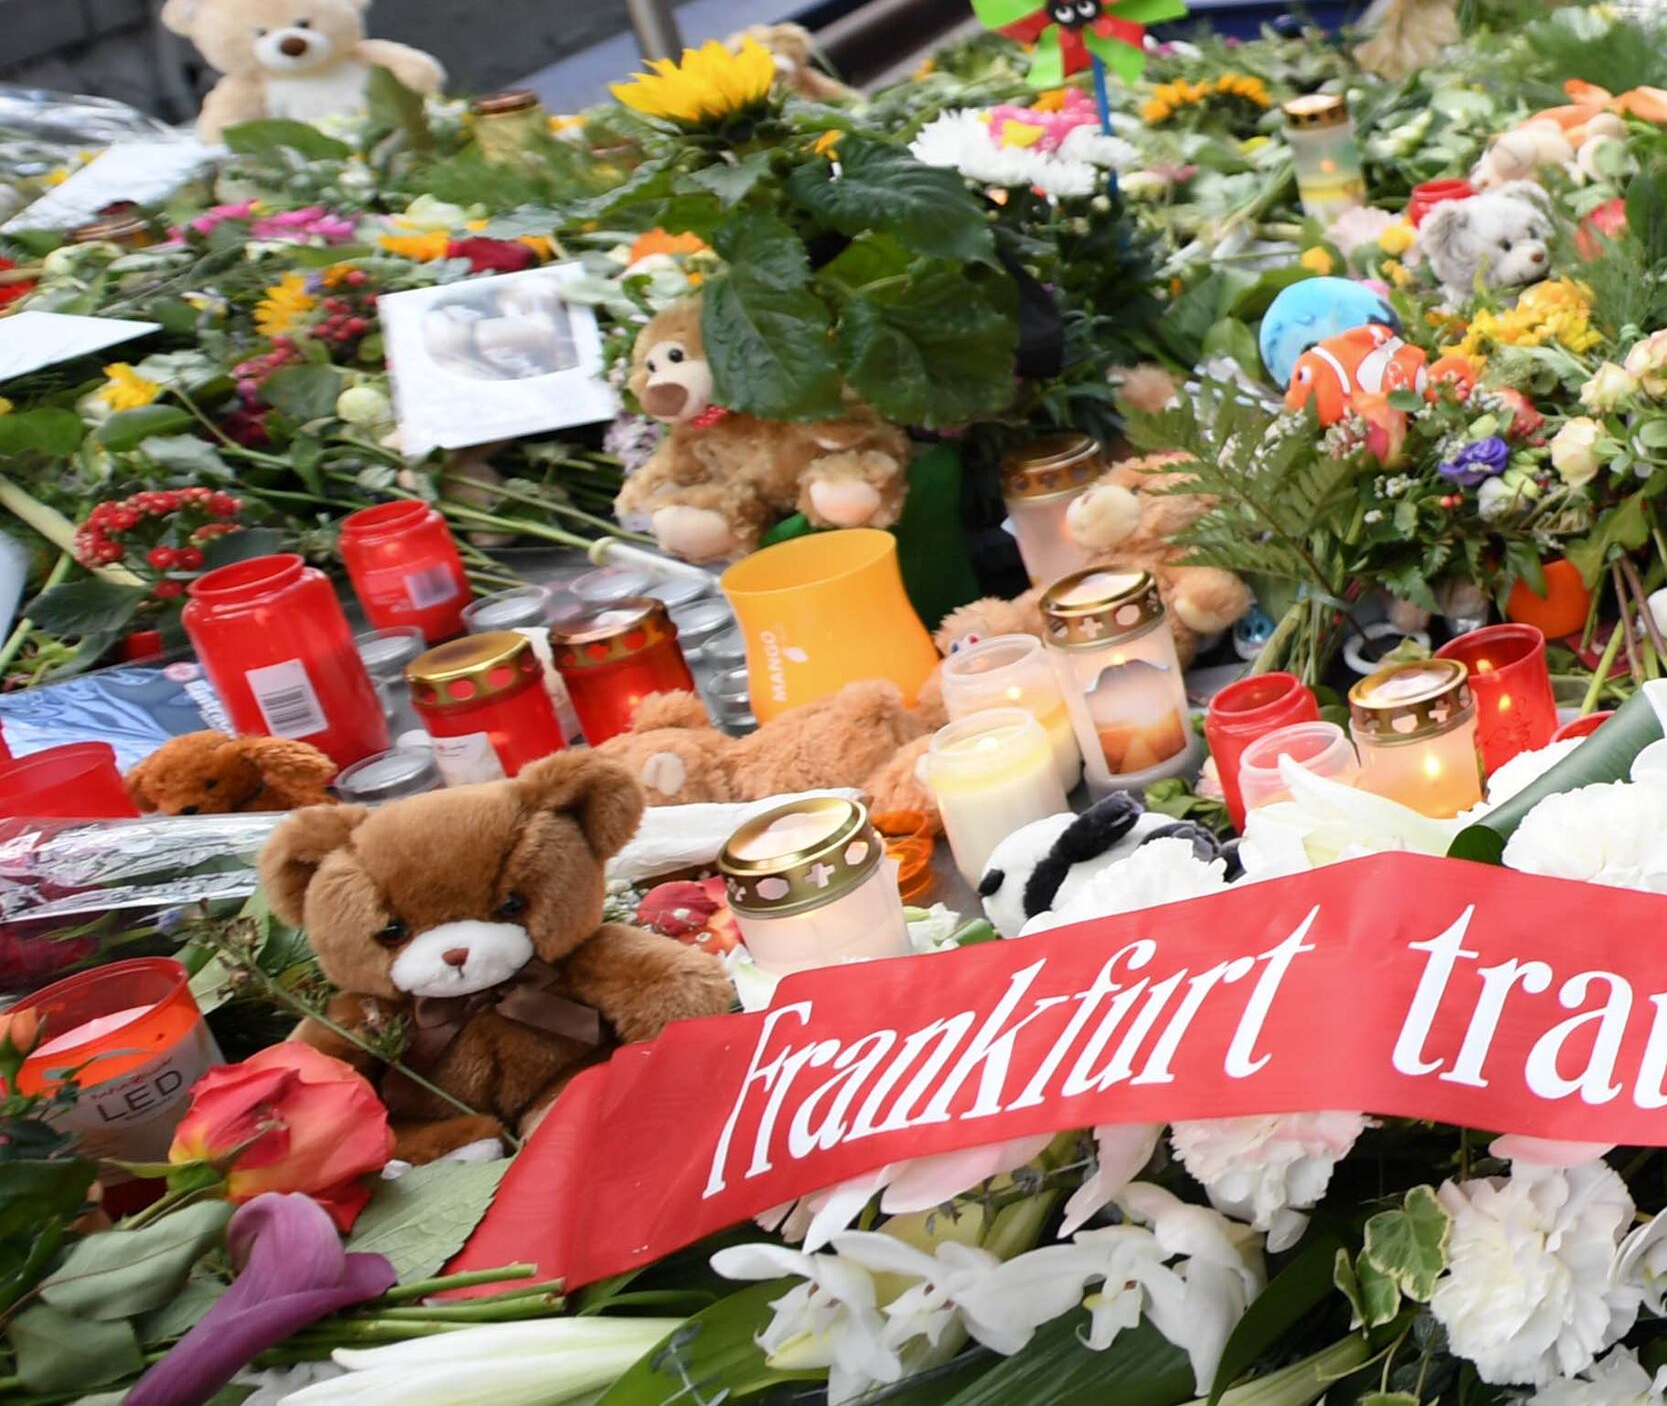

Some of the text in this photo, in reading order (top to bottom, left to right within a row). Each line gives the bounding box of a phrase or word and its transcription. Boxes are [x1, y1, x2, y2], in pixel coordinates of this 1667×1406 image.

[760, 630, 788, 702] MANGO
[703, 904, 1320, 1200] Frankfurt
[97, 1070, 182, 1122] LED
